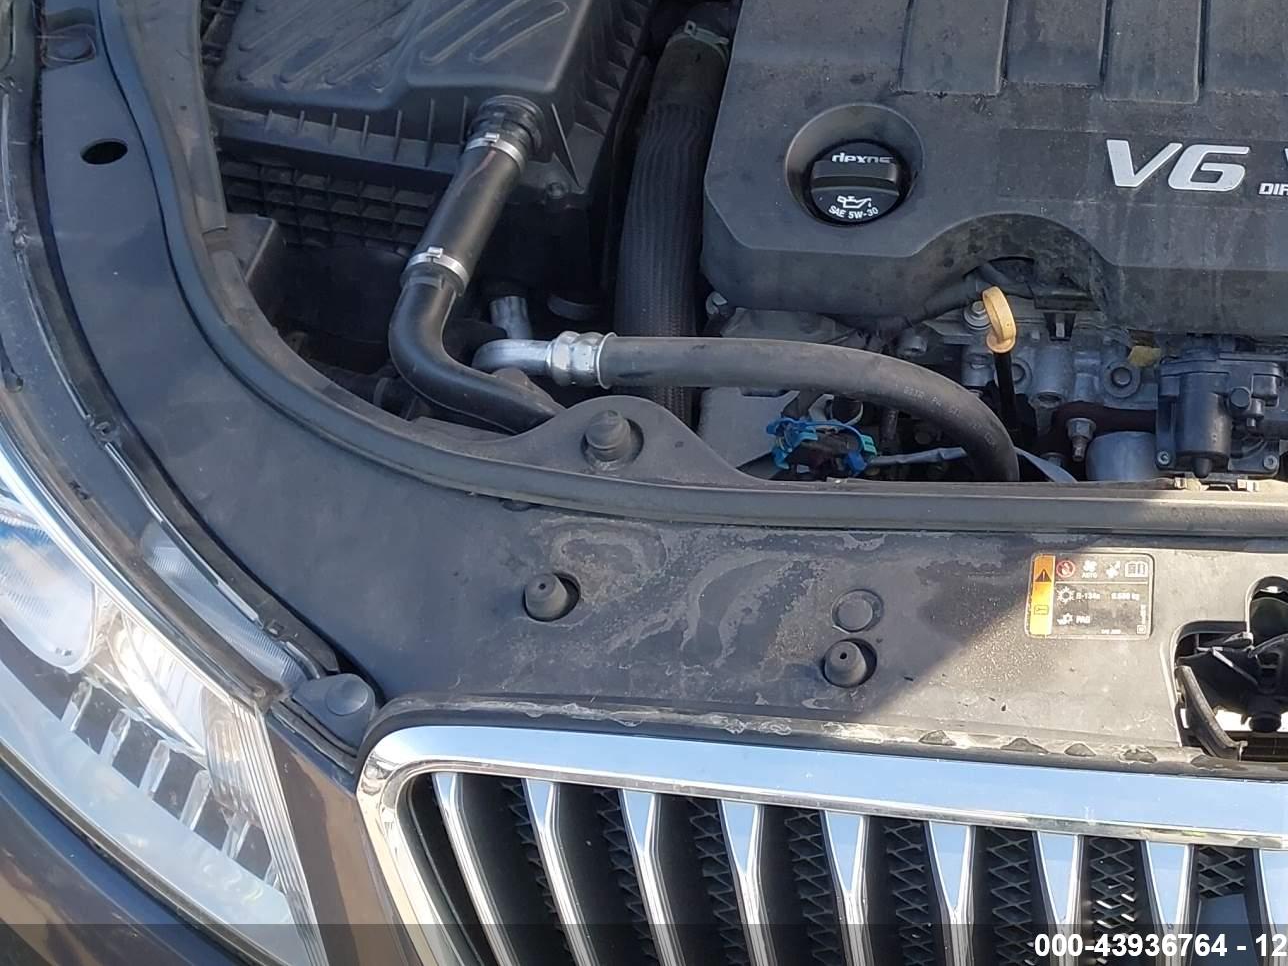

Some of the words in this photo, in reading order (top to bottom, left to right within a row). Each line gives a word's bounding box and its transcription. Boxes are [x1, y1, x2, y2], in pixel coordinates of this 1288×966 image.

[1106, 139, 1251, 192] V6
[828, 205, 846, 218] SAE
[848, 206, 879, 219] 5W-30
